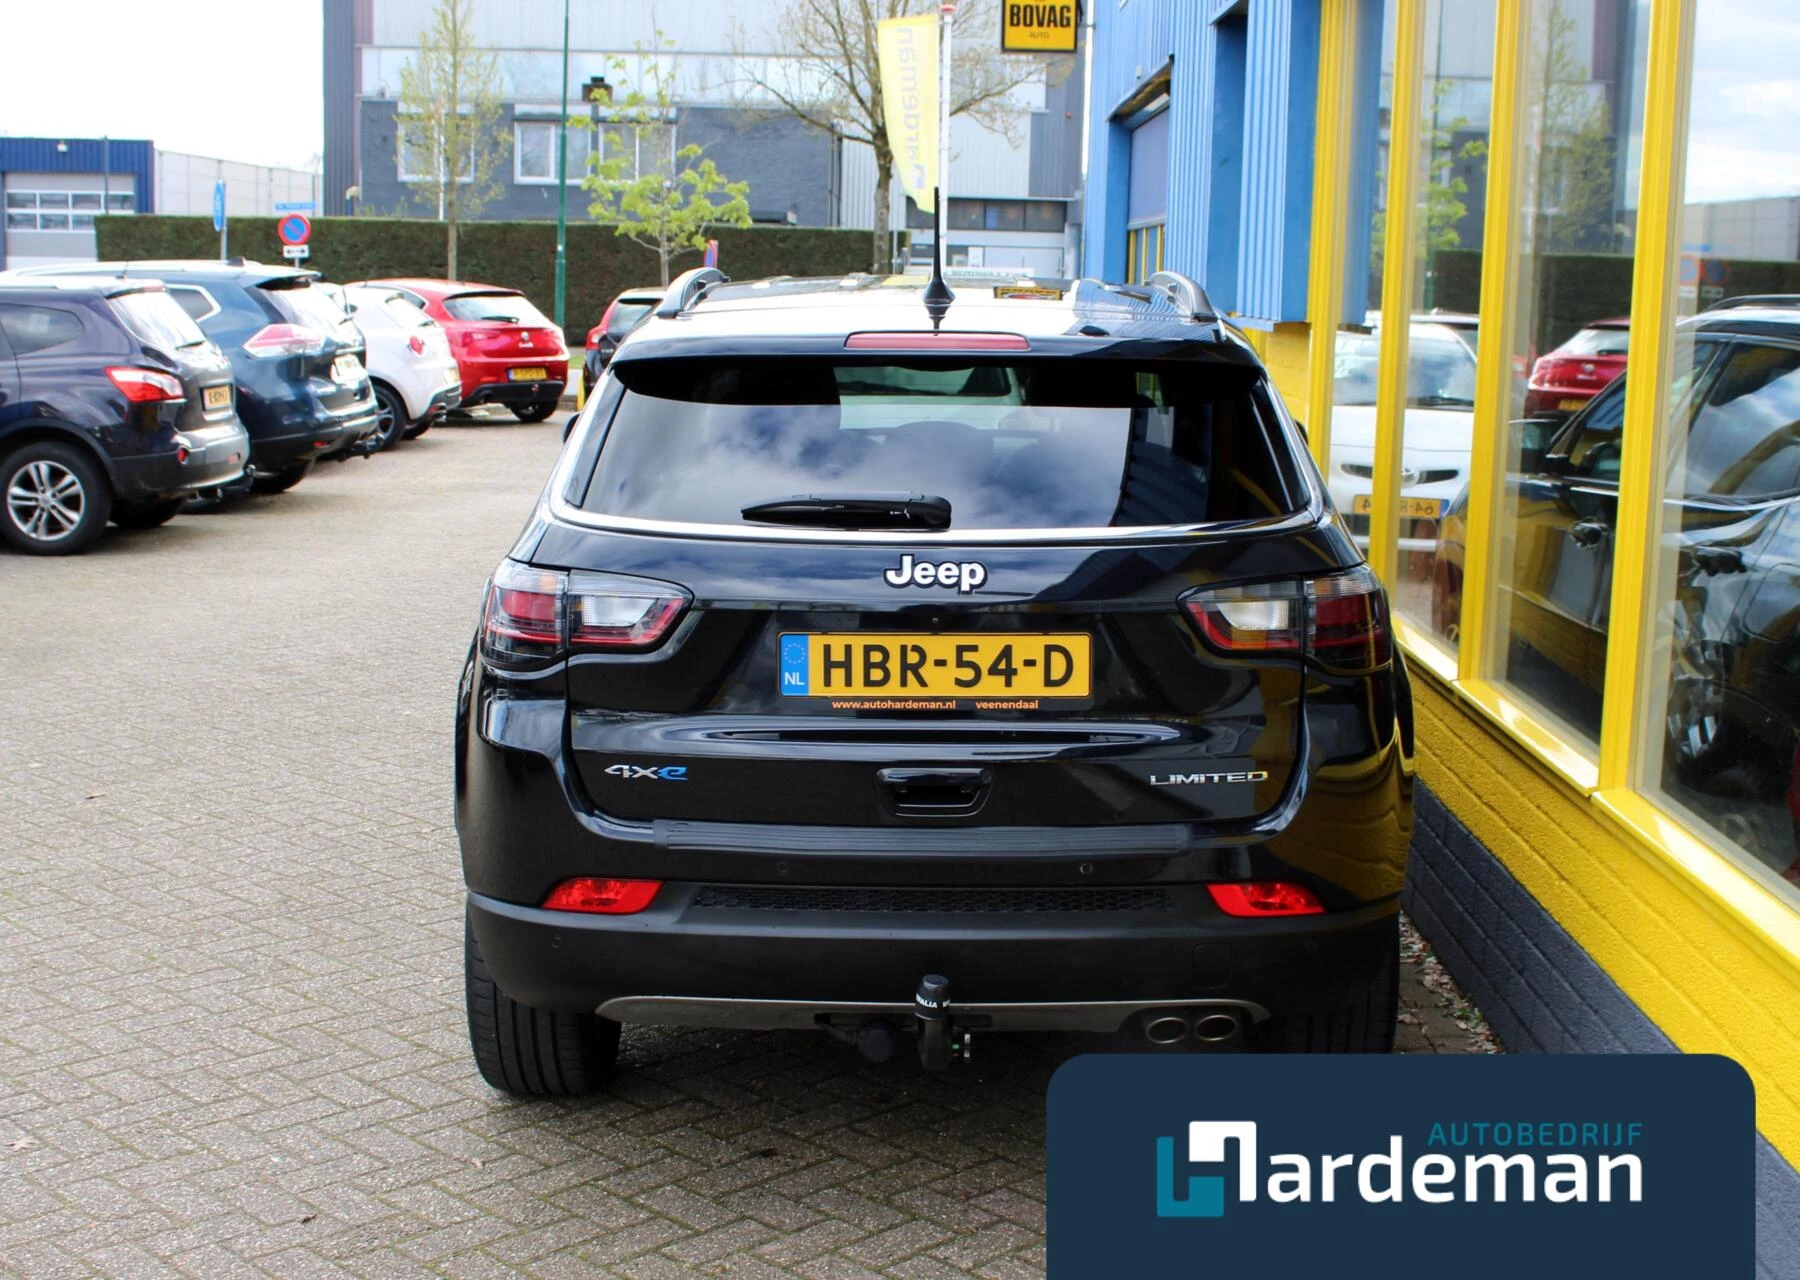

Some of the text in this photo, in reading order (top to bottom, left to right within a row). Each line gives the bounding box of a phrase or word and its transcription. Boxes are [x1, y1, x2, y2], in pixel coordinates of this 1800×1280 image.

[1010, 4, 1071, 28] BOVAG
[885, 554, 986, 593] Jeep
[823, 644, 1074, 688] HBR-54-D
[784, 671, 805, 686] NL
[832, 700, 1039, 710] www.autohardeman.nl veenendaal
[1150, 771, 1268, 785] LIMITED
